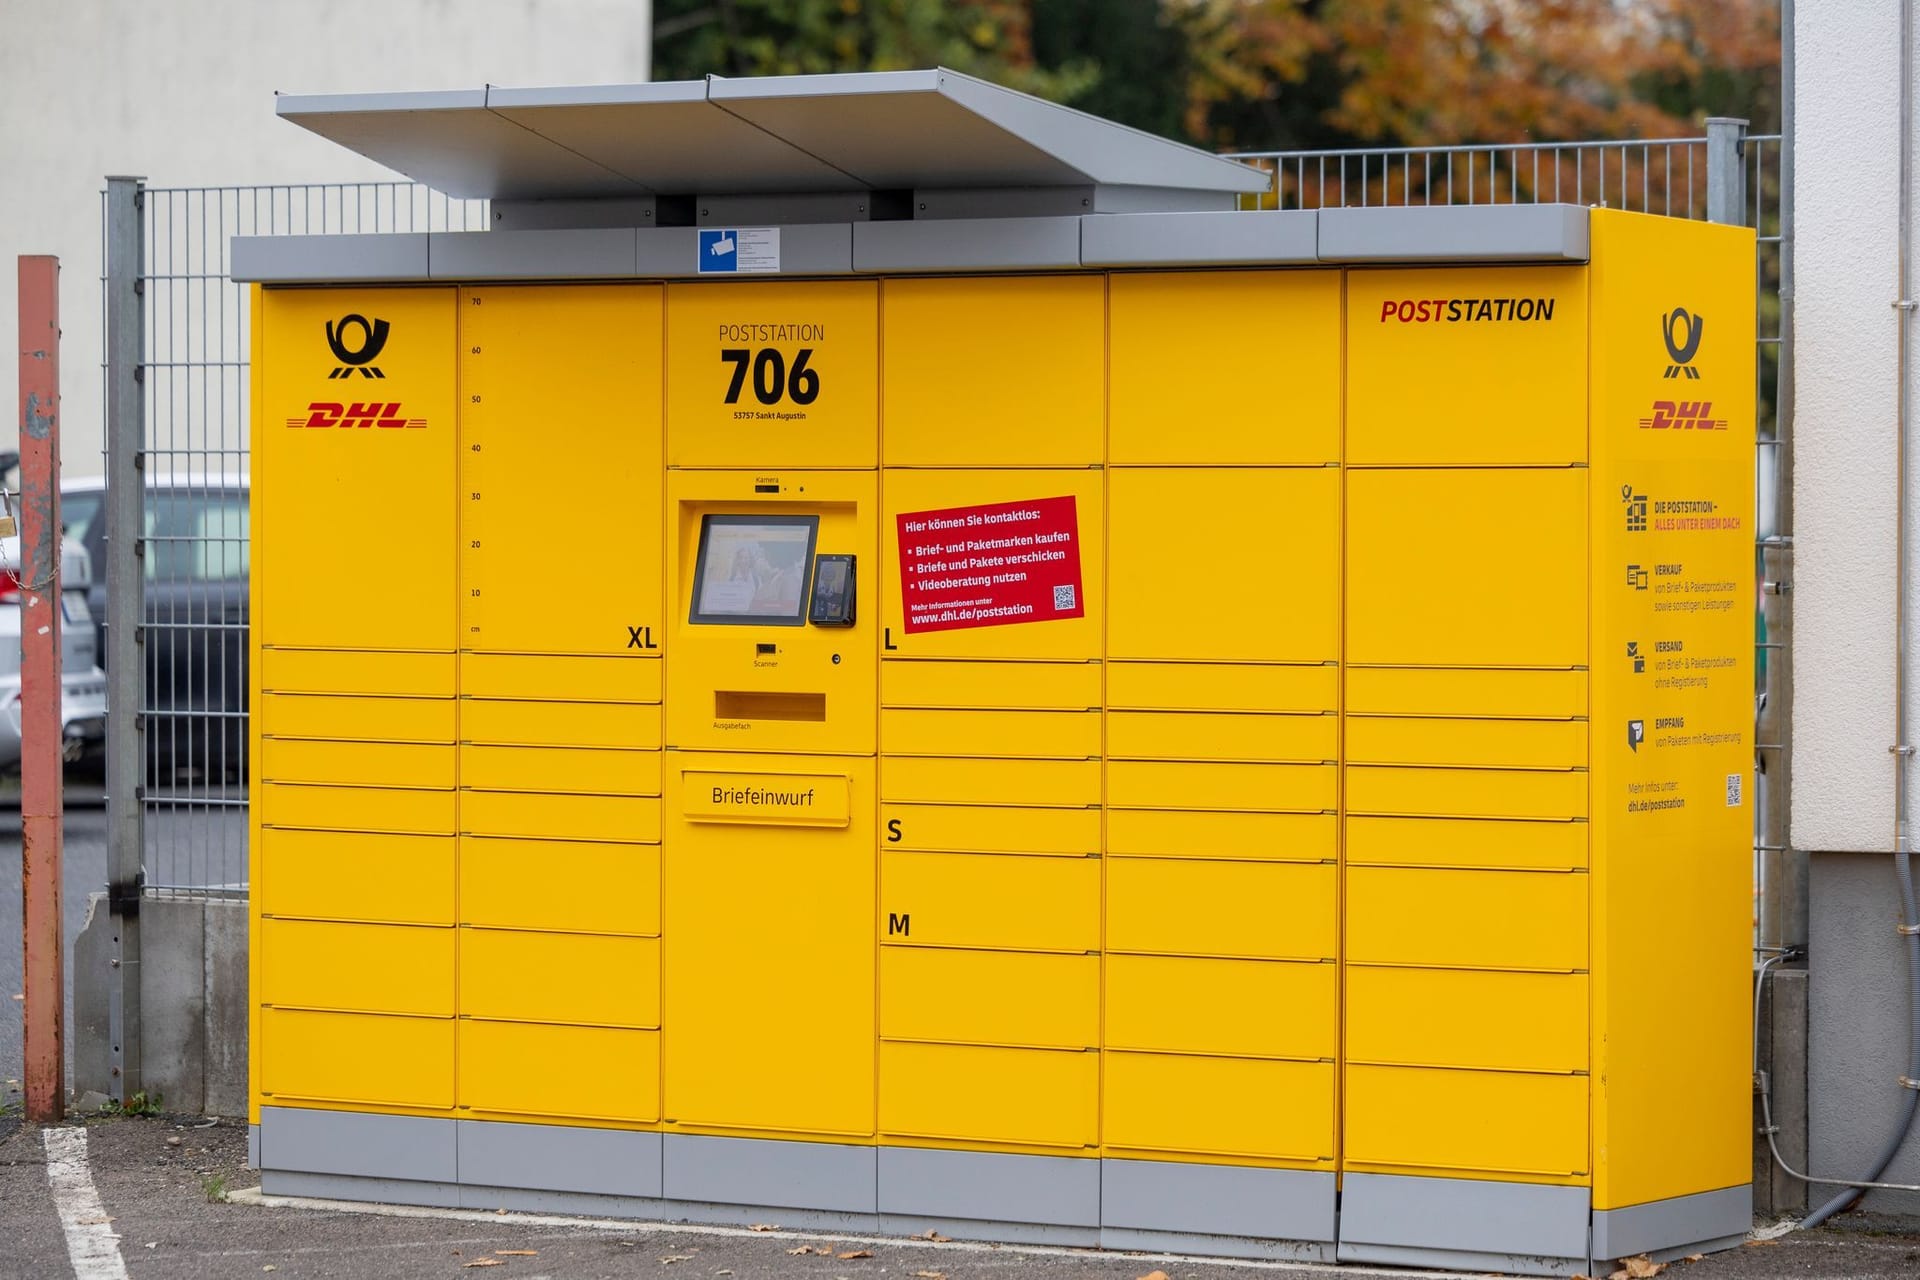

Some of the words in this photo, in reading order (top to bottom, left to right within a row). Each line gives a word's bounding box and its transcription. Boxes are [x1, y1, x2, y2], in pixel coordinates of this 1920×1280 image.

[472, 298, 481, 306] 70
[1380, 298, 1555, 323] POSTSTATION
[719, 324, 824, 341] POSTSTATION
[472, 347, 481, 355] 60
[721, 348, 820, 405] 706
[306, 403, 407, 428] DHL
[734, 411, 754, 419] 53757
[755, 411, 775, 419] Sankt
[776, 411, 806, 421] Augustin
[1651, 401, 1717, 430] DHL
[471, 444, 481, 452] 40
[471, 493, 481, 501] 30
[1655, 502, 1665, 513] DIE
[905, 521, 926, 532] Hier
[928, 517, 965, 531] können
[967, 514, 982, 526] Sie
[984, 509, 1041, 524] kontaktlos:
[1655, 519, 1674, 530] ALLES
[1677, 518, 1698, 530] UNTER
[1701, 518, 1720, 529] EINEM
[1723, 517, 1740, 529] DACH
[471, 540, 481, 548] 20
[915, 545, 944, 557] Brief-
[946, 542, 965, 553] und
[967, 536, 1033, 551] Paketmarken
[1035, 531, 1070, 545] kaufen
[917, 562, 946, 574] Briefe
[949, 559, 967, 571] und
[970, 555, 1003, 568] Pakete
[1005, 550, 1065, 564] verschicken
[1655, 564, 1682, 575] VERKAUF
[918, 573, 991, 591] Videoberatung
[993, 571, 1027, 583] nutzen
[1655, 584, 1665, 593] von
[1685, 581, 1689, 592] &
[1691, 581, 1736, 593] Paketprodukten
[471, 589, 480, 597] 10
[911, 604, 928, 612] Mehr
[929, 599, 974, 610] Informationen
[975, 598, 993, 606] unter
[1655, 602, 1671, 612] sowie
[1673, 601, 1700, 613] sonstigen
[1702, 600, 1734, 612] Leistungen
[911, 603, 1033, 624] www.dhl.de/poststation
[627, 627, 657, 648] XL
[885, 628, 897, 650] L
[1655, 641, 1683, 652] VERSAND
[754, 660, 778, 668] Scanner
[1655, 661, 1665, 670] von
[1685, 657, 1689, 669] &
[1691, 657, 1736, 670] Paketprodukten
[1655, 676, 1670, 688] ohne
[713, 722, 751, 730] Ausgabefach
[1655, 717, 1684, 729] EMPFANG
[1655, 738, 1666, 747] von
[1668, 735, 1690, 746] Paketen
[1692, 734, 1702, 744] mit
[1628, 782, 1644, 793] Mehr
[1645, 781, 1660, 792] Infos
[712, 787, 814, 806] Briefeinwurf
[1628, 796, 1685, 813] dhl.de/poststation
[887, 819, 902, 842] S
[888, 913, 910, 936] M
